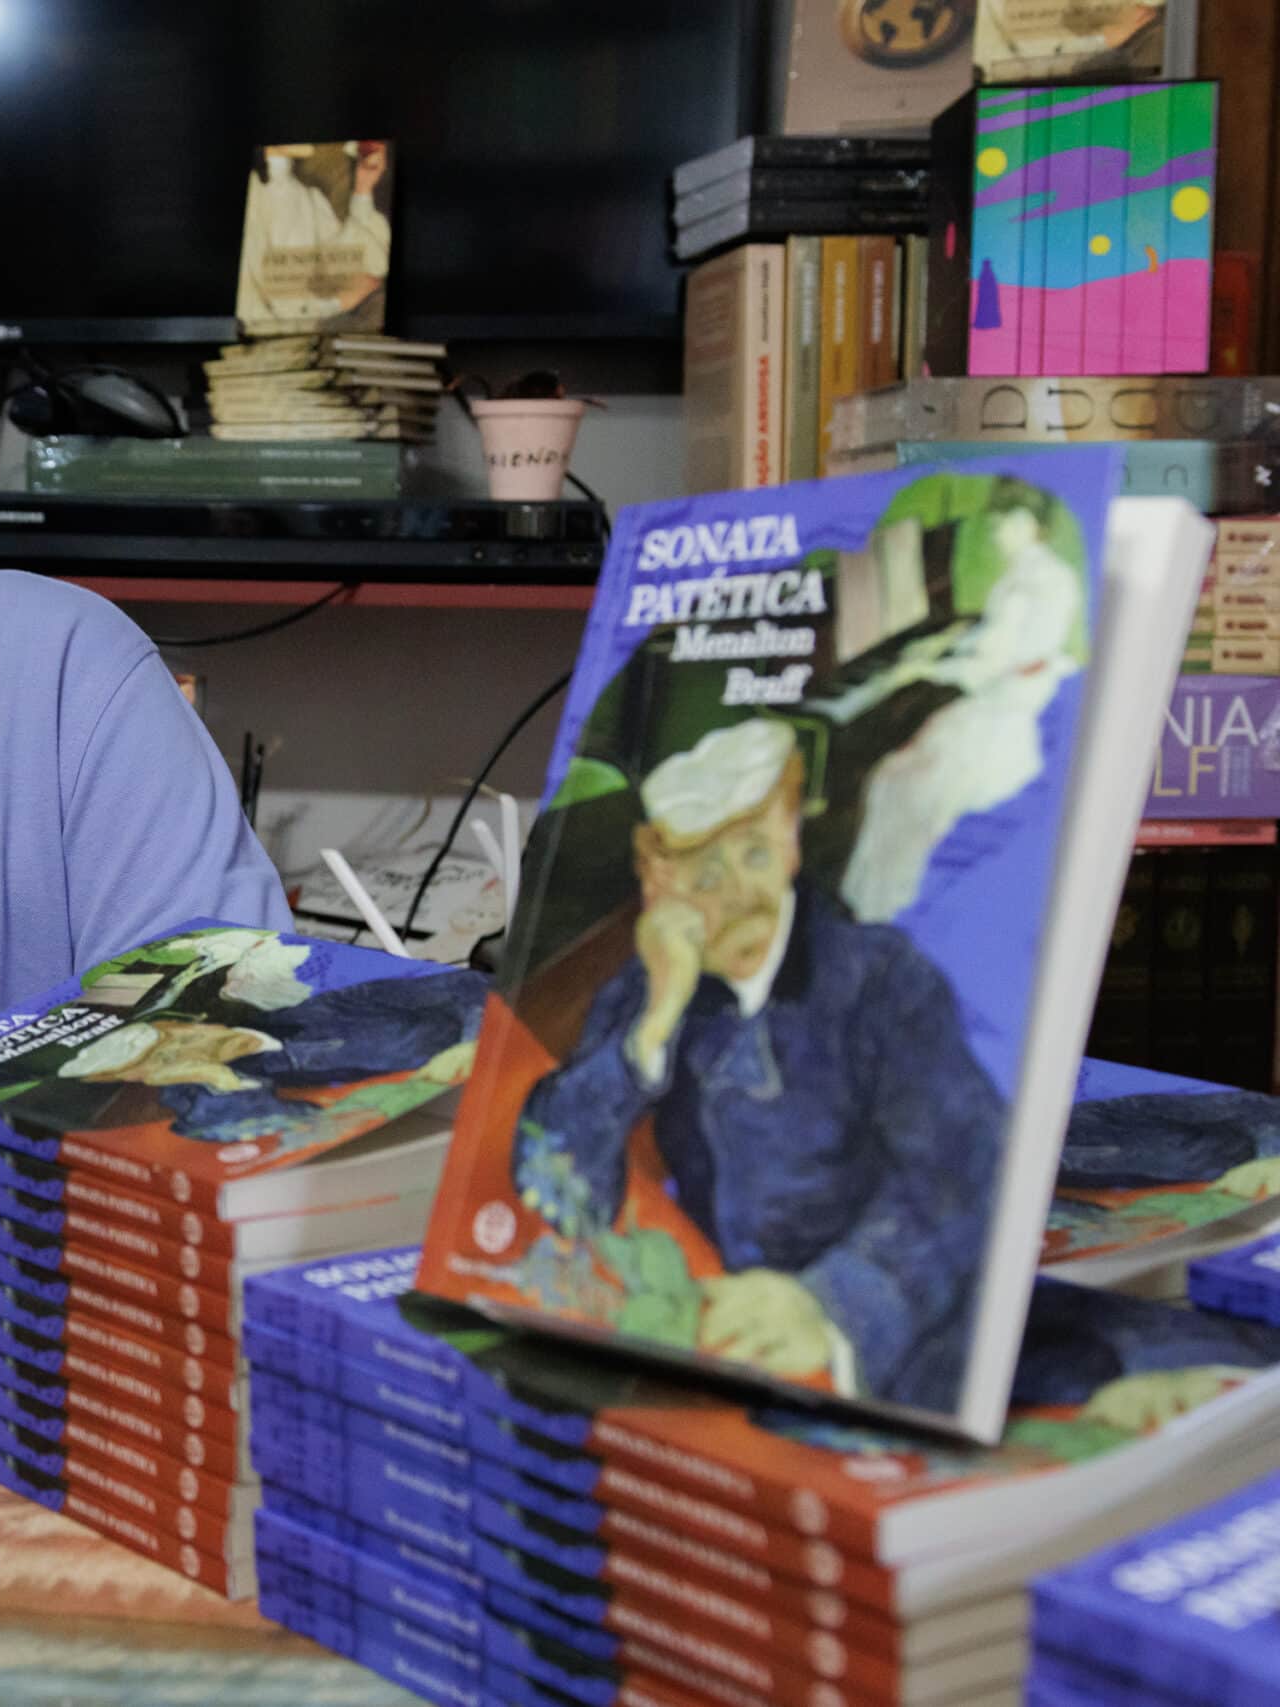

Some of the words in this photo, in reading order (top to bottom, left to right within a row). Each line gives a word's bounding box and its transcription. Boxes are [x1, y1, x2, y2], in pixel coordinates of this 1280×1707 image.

[636, 514, 802, 571] SONATA
[622, 566, 828, 627] PATÉTICA
[669, 620, 816, 663] Menalton
[55, 1013, 126, 1049] Braff
